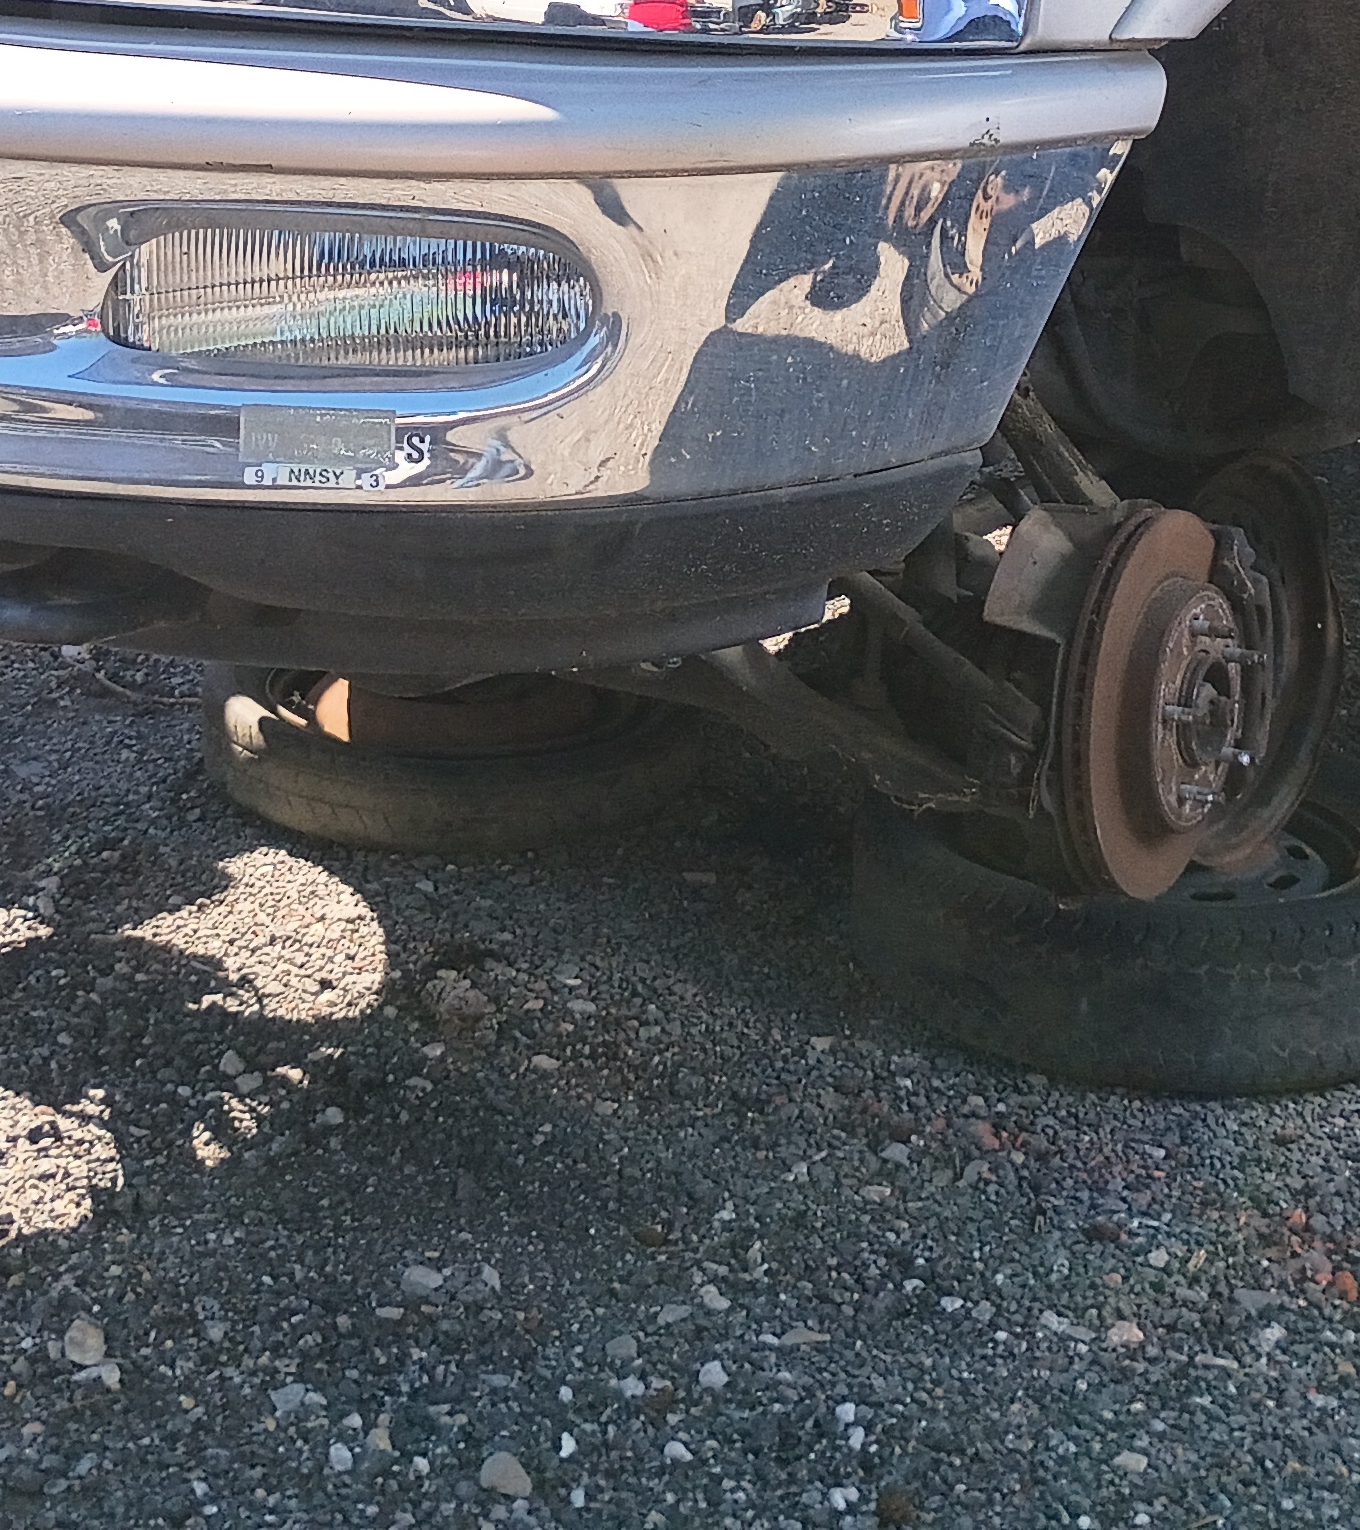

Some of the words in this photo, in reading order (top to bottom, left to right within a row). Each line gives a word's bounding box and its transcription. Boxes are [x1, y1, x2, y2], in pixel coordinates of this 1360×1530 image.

[406, 432, 426, 464] S
[254, 469, 265, 484] 9
[289, 468, 343, 485] NNSY
[370, 474, 379, 488] 3
